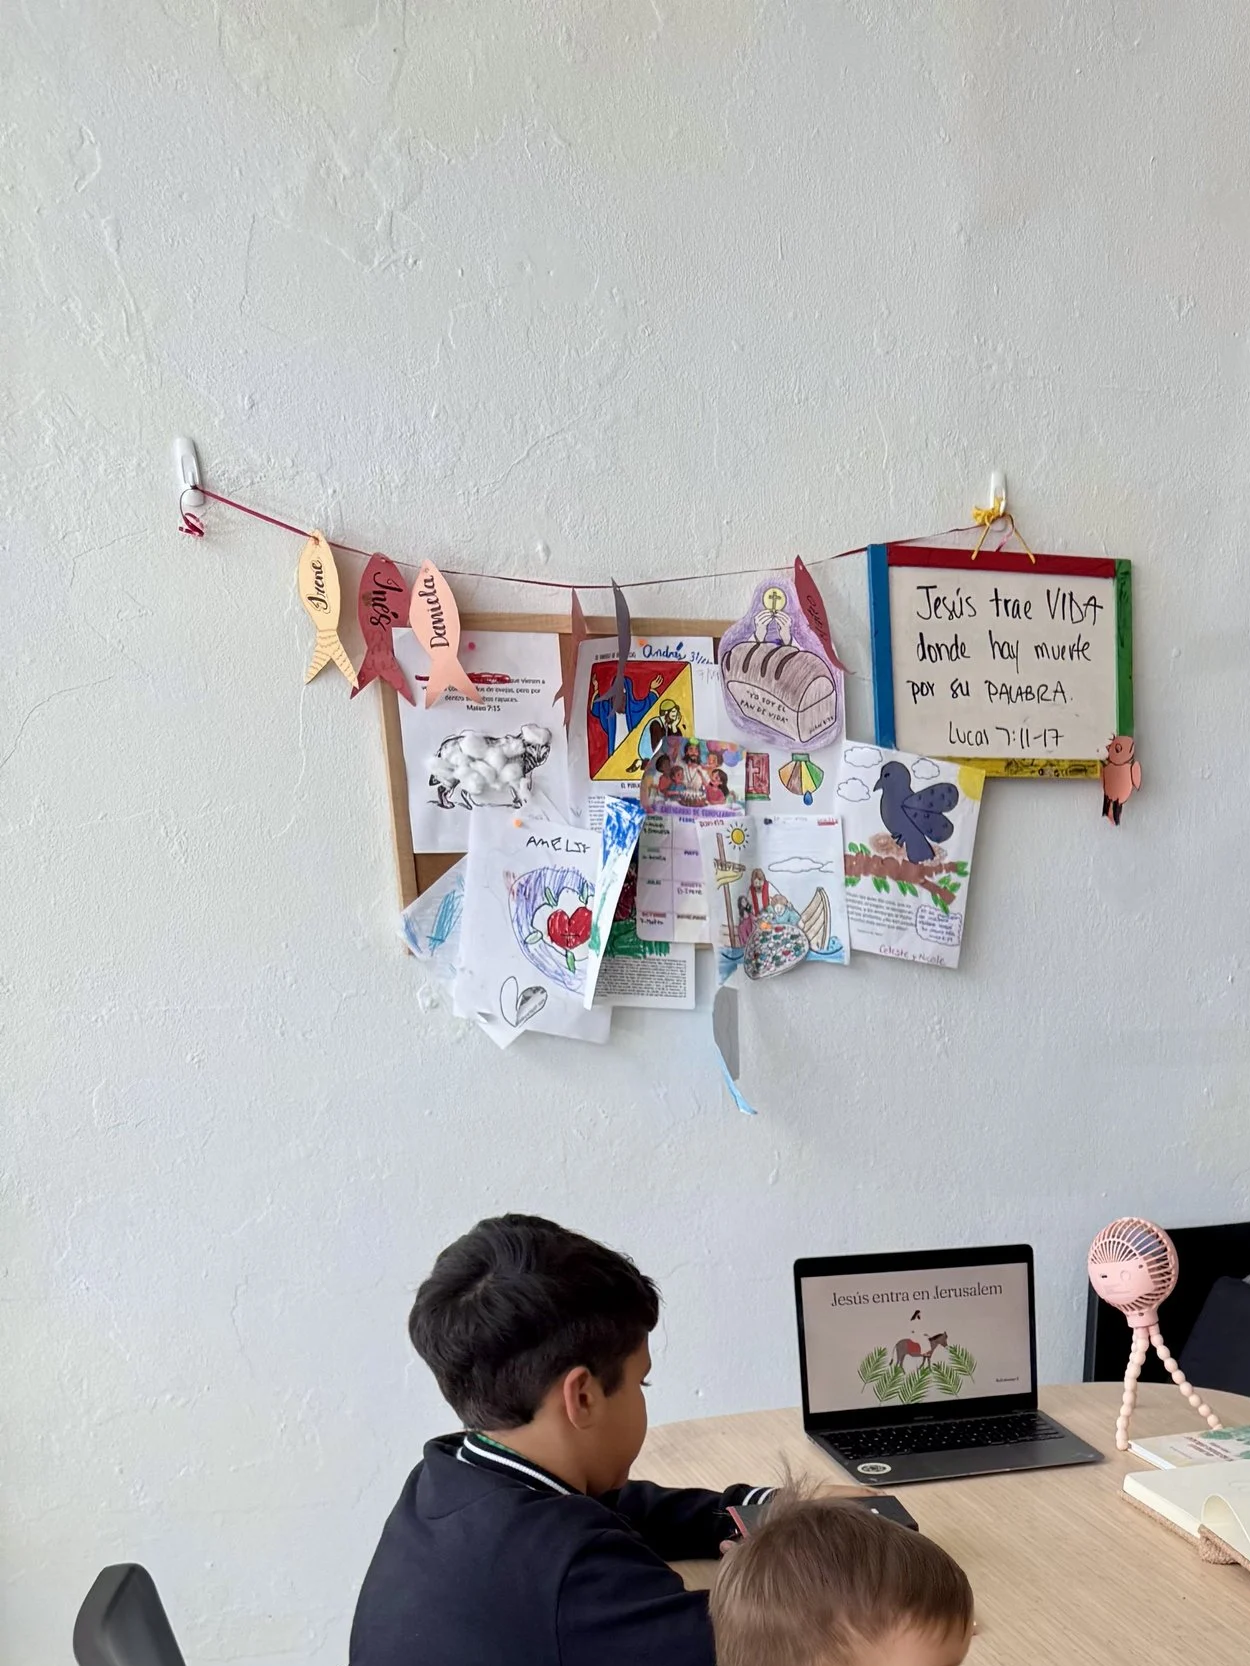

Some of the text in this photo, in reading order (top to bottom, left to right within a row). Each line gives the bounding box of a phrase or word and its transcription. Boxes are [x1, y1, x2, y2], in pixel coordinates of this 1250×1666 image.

[307, 558, 331, 615] Irene
[369, 571, 404, 633] Inés
[916, 584, 1104, 626] Jesús trae VIDA
[418, 574, 450, 650] Daniela
[916, 629, 1092, 674] donde hay muerte
[487, 704, 501, 712] 7:15
[907, 678, 1074, 705] por su PALABRA.
[948, 721, 1065, 750] Lucas 7:11-17
[831, 1281, 1003, 1307] Jesús entra en Jerusalem
